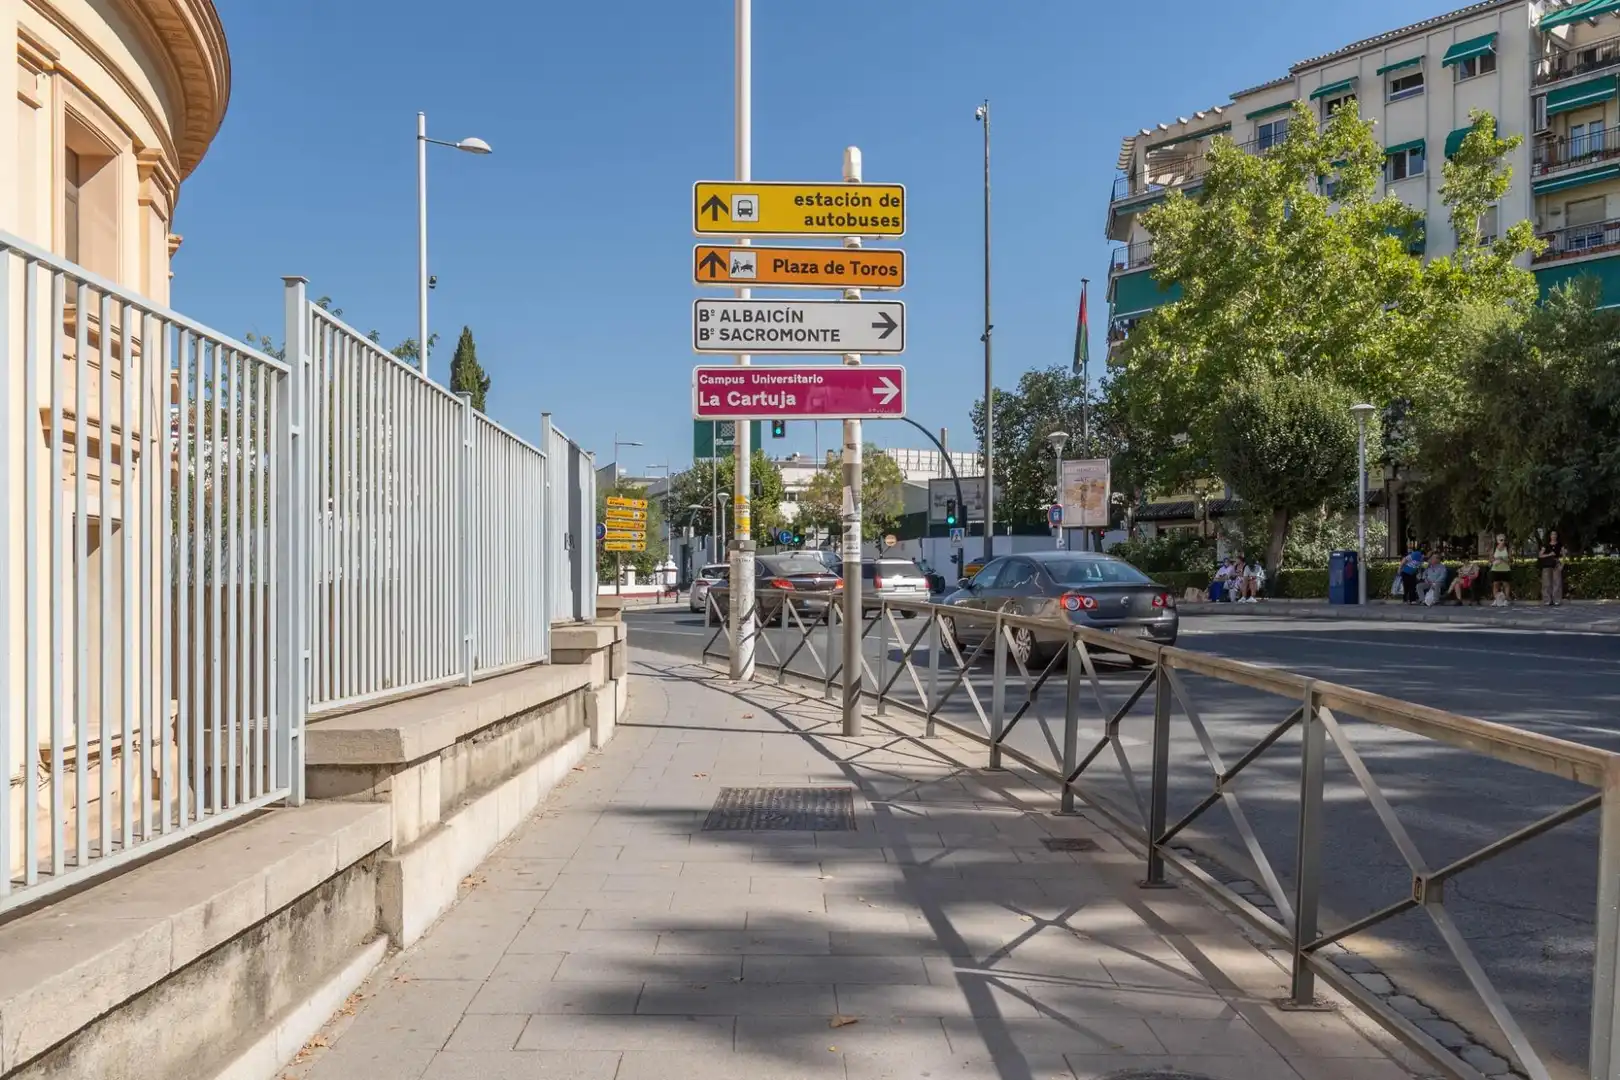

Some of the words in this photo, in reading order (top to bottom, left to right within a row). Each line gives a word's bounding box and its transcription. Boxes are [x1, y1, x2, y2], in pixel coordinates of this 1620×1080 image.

[794, 192, 872, 207] estación
[879, 193, 900, 208] de
[804, 212, 900, 227] autobuses
[773, 259, 819, 274] Plaza
[824, 260, 845, 275] de
[850, 261, 898, 276] Toros
[719, 307, 804, 323] ALBAICÍN
[719, 328, 841, 342] SACROMONTE
[699, 374, 745, 386] Campus
[752, 373, 824, 385] Universitario
[699, 391, 720, 406] La
[727, 391, 797, 409] Cartuja
